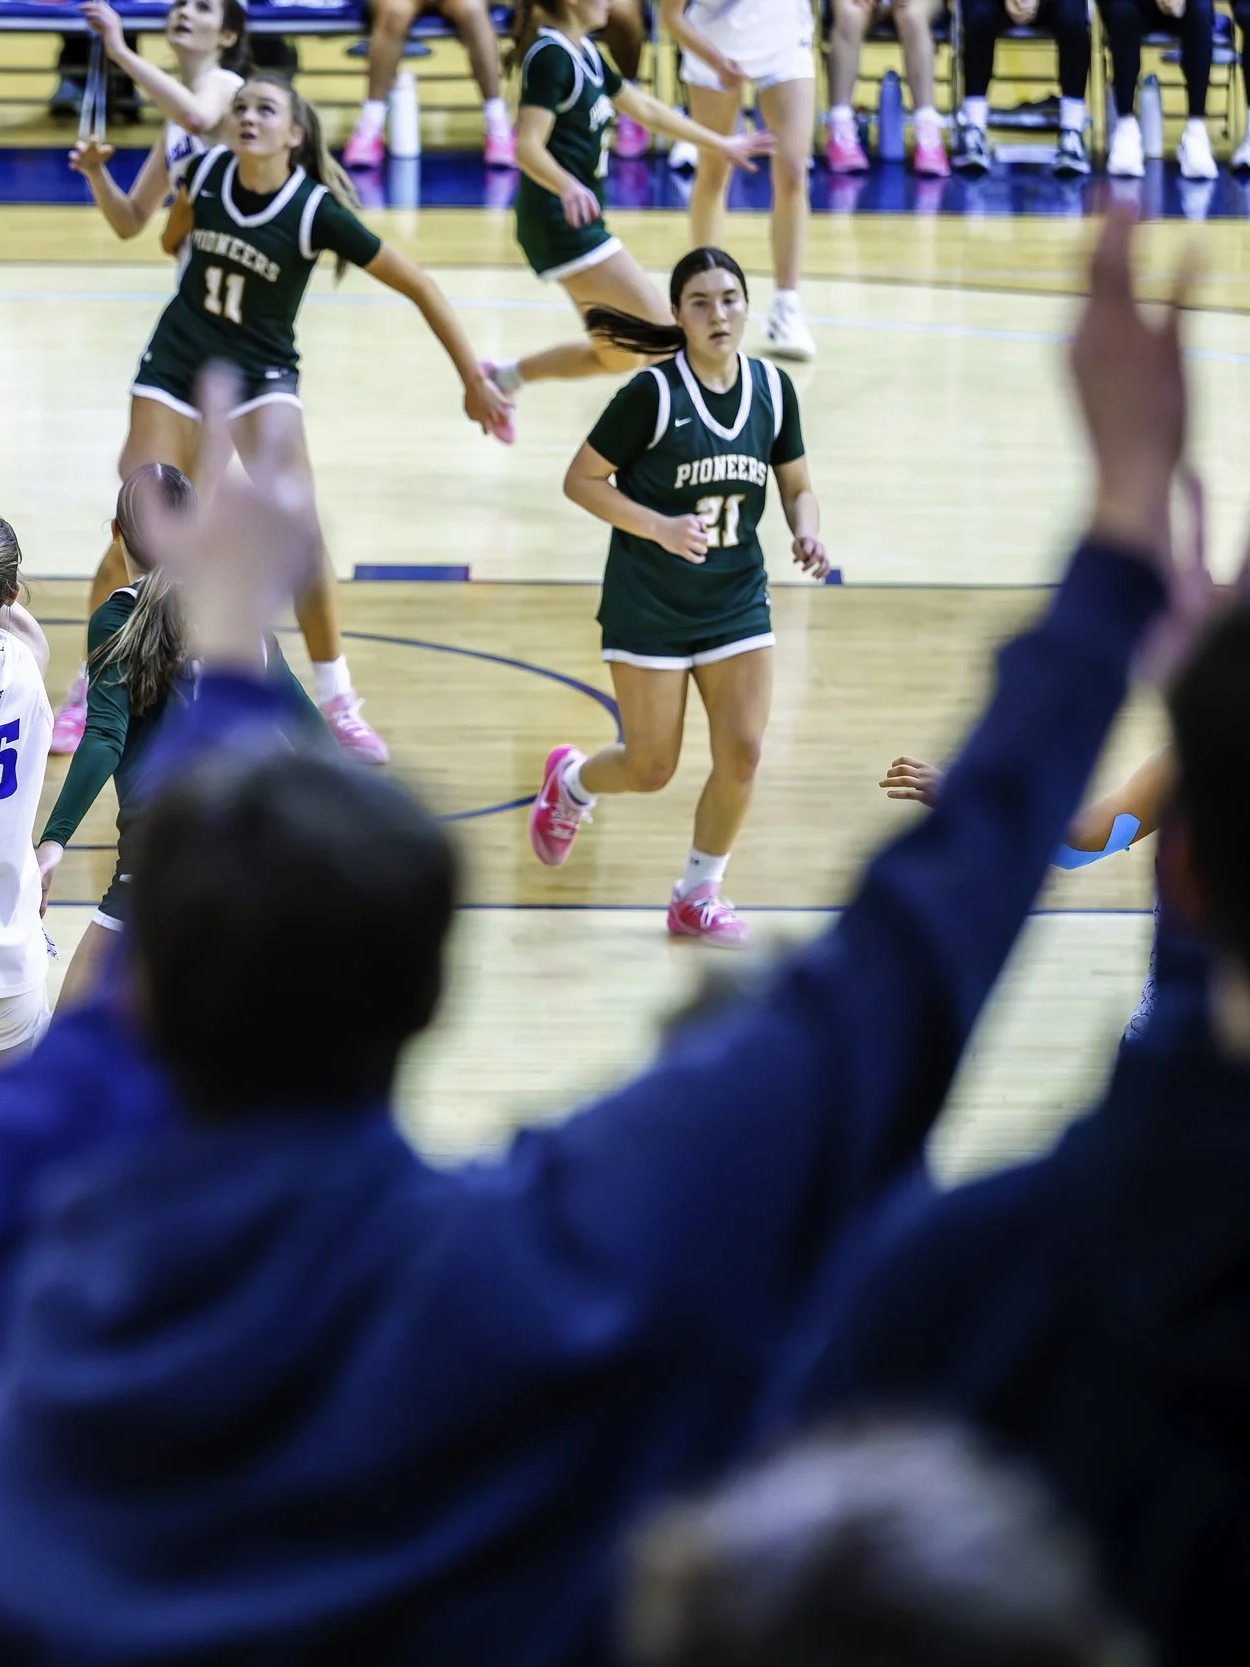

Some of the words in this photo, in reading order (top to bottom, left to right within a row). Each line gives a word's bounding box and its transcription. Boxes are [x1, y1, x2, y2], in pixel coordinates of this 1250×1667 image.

[204, 265, 246, 325] 11
[674, 454, 767, 489] PIONEERS
[696, 494, 746, 548] 21
